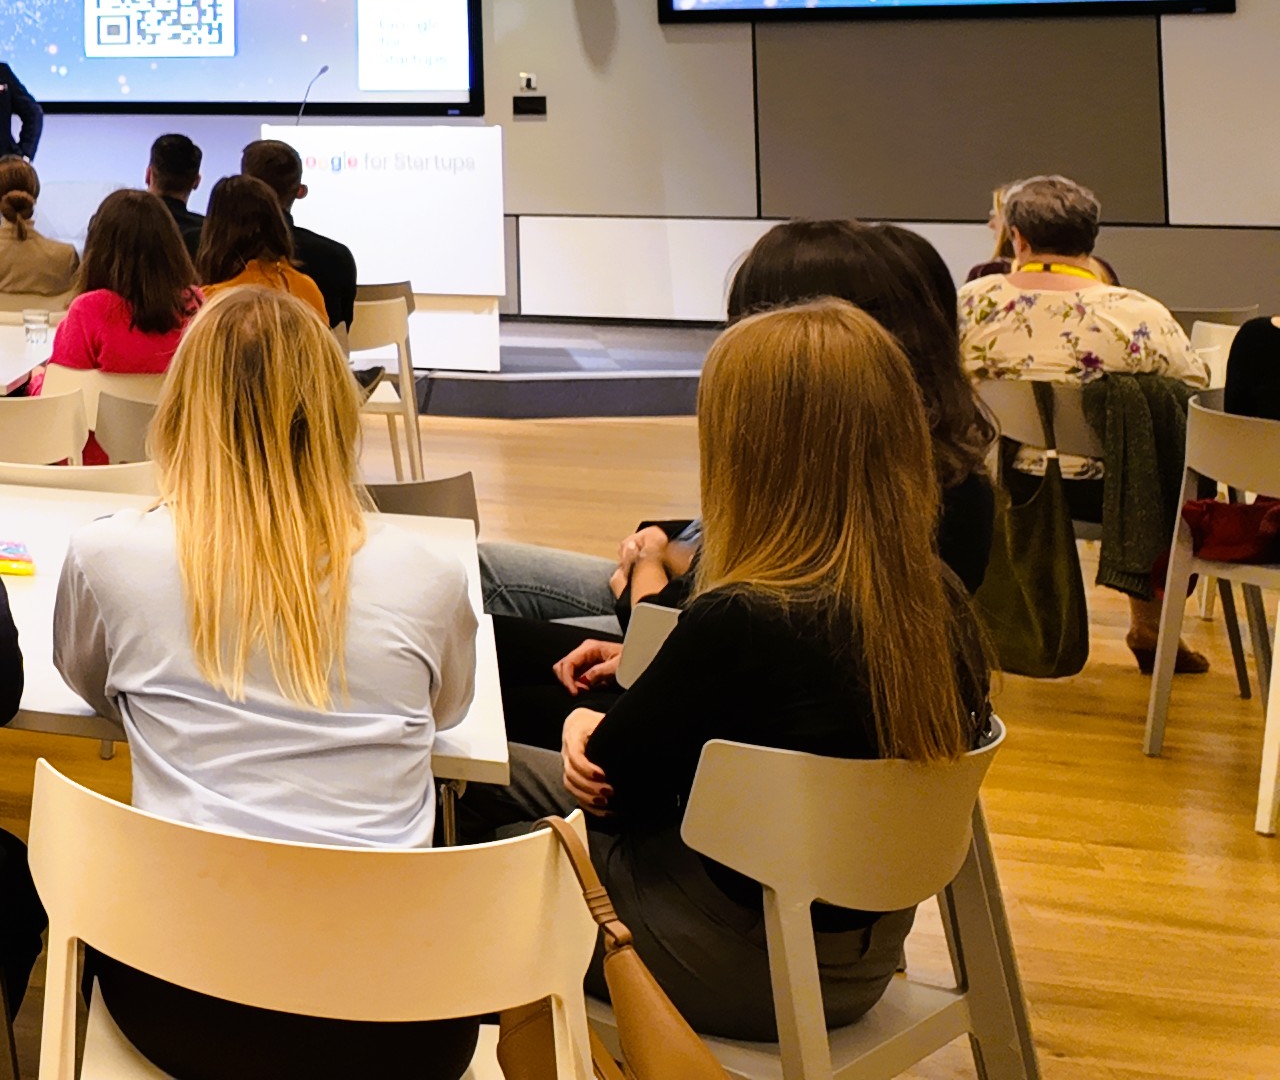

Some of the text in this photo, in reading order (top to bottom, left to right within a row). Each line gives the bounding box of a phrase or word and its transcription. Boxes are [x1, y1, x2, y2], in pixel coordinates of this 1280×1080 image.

[300, 152, 475, 175] oogle for Startups
